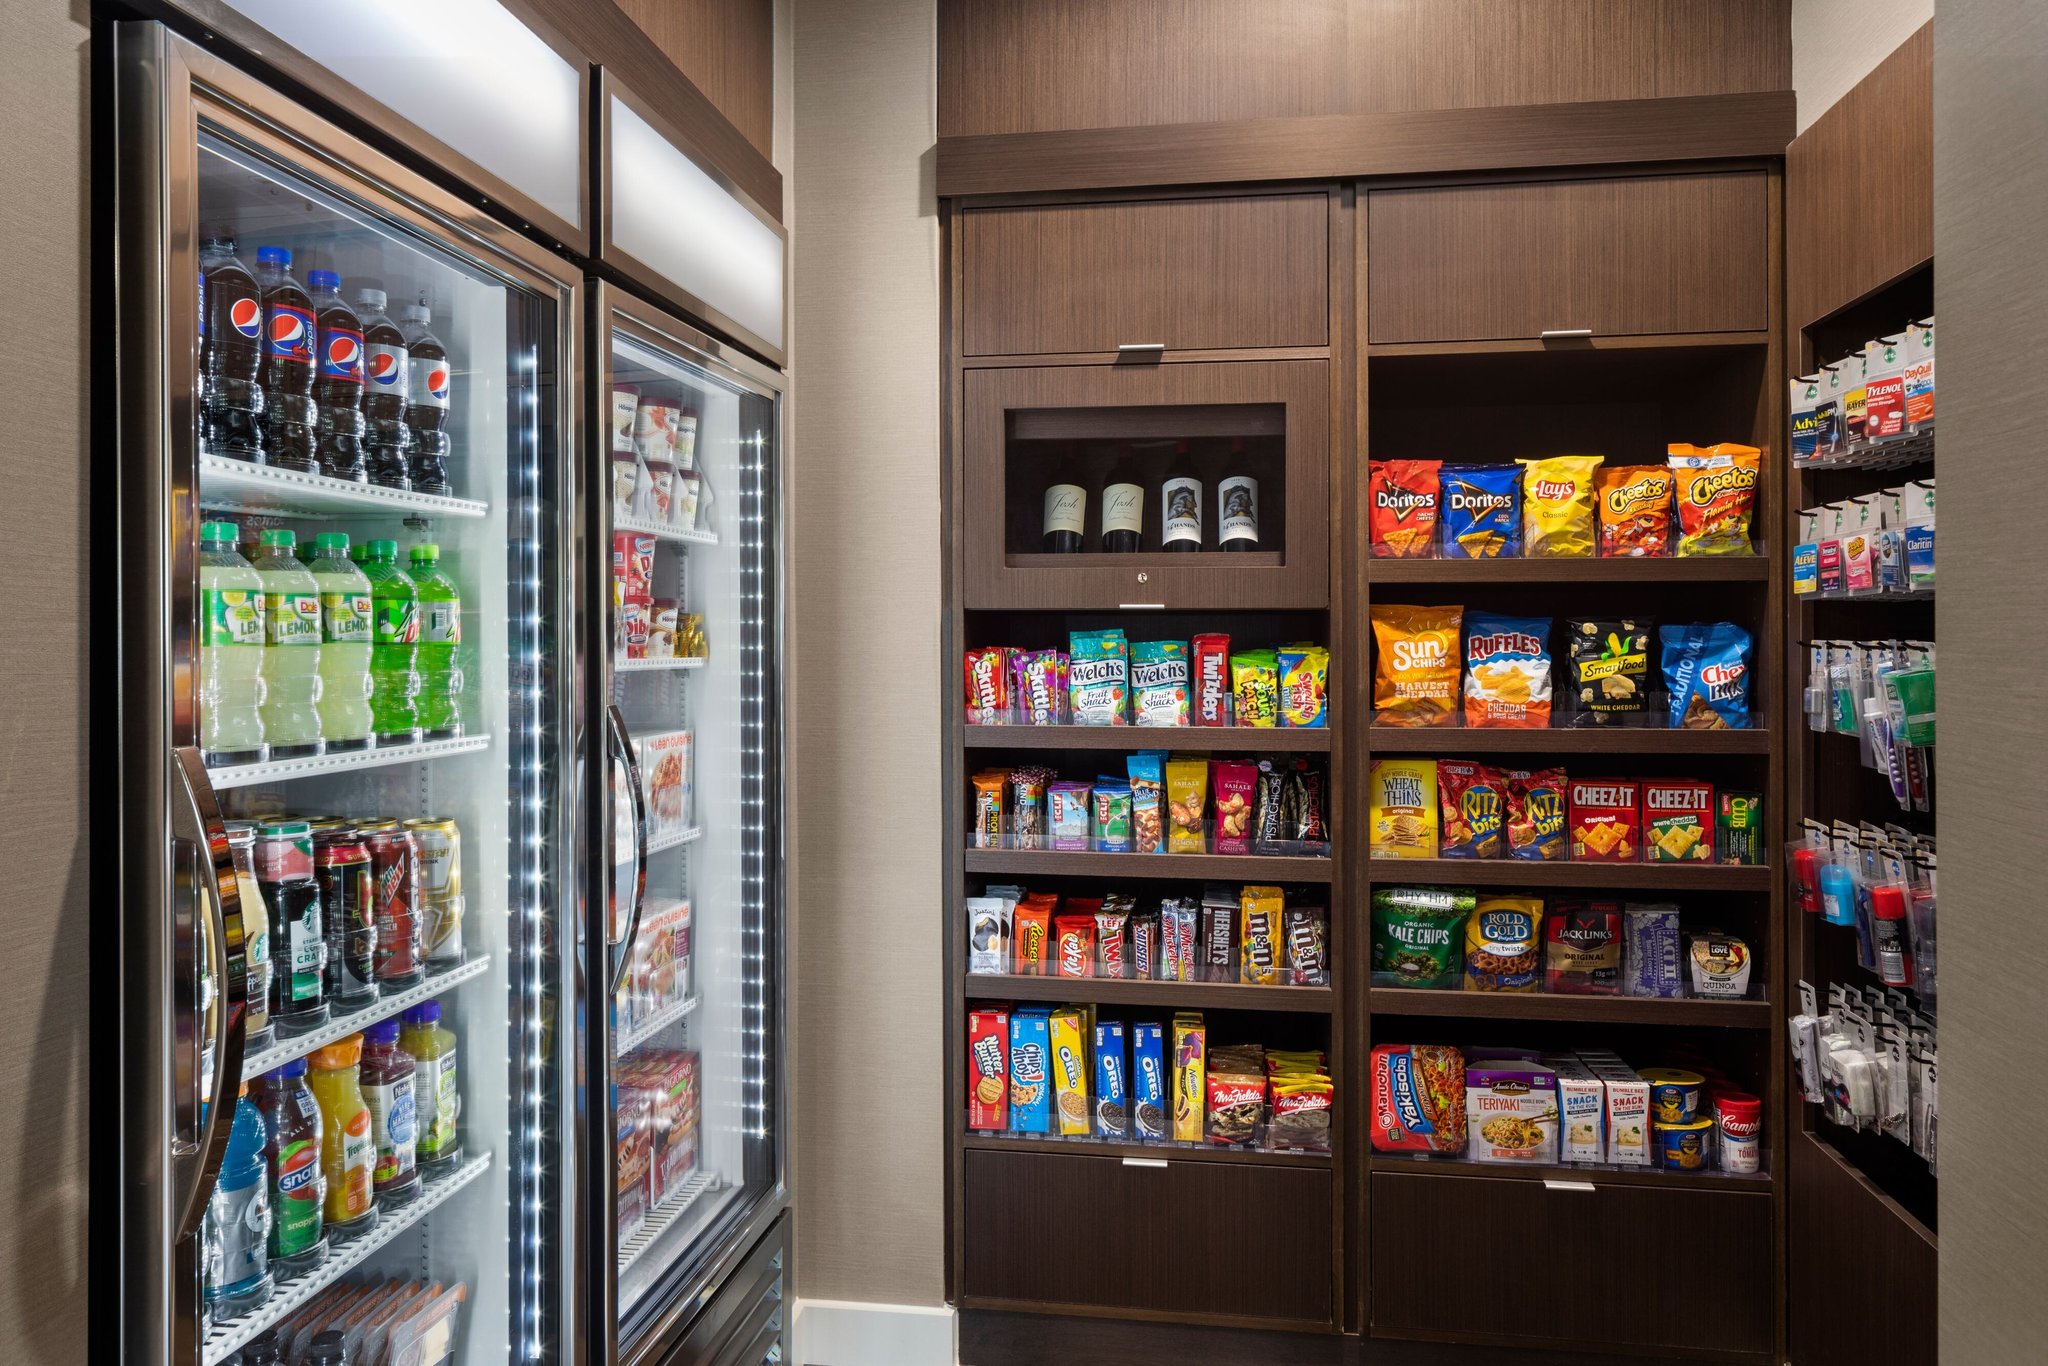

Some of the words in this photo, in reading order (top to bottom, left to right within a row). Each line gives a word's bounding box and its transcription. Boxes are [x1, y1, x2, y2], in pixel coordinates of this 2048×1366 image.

[1904, 362, 1932, 380] DayQuil
[1867, 383, 1902, 398] TYLENOL
[1846, 400, 1866, 411] BAYER
[1793, 418, 1818, 430] Advi
[1538, 481, 1573, 501] Lay's
[1691, 467, 1756, 506] Cheetos
[1378, 492, 1434, 508] Doritos
[1452, 493, 1512, 508] Doritos
[1610, 480, 1665, 513] Cheetos
[1542, 510, 1569, 519] Classic
[1908, 540, 1932, 550] Claritin
[1795, 555, 1816, 565] ALEVE
[1393, 640, 1448, 671] Sun
[1469, 632, 1541, 661] RUFFLES
[1073, 663, 1124, 681] Welch's
[1412, 658, 1446, 668] CHIPS
[1134, 664, 1186, 684] Welch's
[1670, 636, 1704, 716] TRADITIONAL
[974, 660, 996, 726] Skittles
[1087, 690, 1108, 700] Fruit
[1395, 690, 1450, 698] CHEDDAR
[1396, 681, 1450, 692] HARVEST
[1081, 698, 1112, 708] Snacks
[1144, 699, 1176, 709] Snacks
[1151, 692, 1171, 700] Fruit
[1242, 680, 1259, 720] PATCH
[1254, 682, 1271, 717] SOUR
[1488, 703, 1526, 713] CHEDDAR
[1612, 703, 1641, 711] CHEDDAR
[1383, 777, 1422, 790] WHEAT
[1463, 790, 1500, 820] RITZ
[1731, 798, 1748, 828] CLUB
[990, 811, 998, 848] PROTEIN
[1102, 919, 1122, 928] LEFT
[1488, 913, 1524, 925] ROLD
[1388, 924, 1414, 943] KALE
[1417, 928, 1450, 945] CHIPS
[1485, 924, 1528, 940] GOLD
[1558, 930, 1584, 940] JACK
[1103, 930, 1124, 978] TWIX
[1136, 928, 1148, 971] SATISFIES
[1662, 936, 1675, 962] ACT
[1702, 982, 1736, 990] QUINOA
[974, 1041, 995, 1078] Butter
[984, 1036, 1004, 1074] Nutter
[1023, 1044, 1040, 1076] Chips
[1059, 1046, 1077, 1088] OREO
[1103, 1056, 1118, 1099] OREO
[1142, 1056, 1158, 1100] OREO
[1188, 1068, 1198, 1098] Newtons
[1377, 1054, 1388, 1117] Maruchan
[1395, 1058, 1421, 1130] Yakisoba
[1566, 1095, 1598, 1106] SNACK
[1613, 1096, 1644, 1106] SNACK
[1477, 1098, 1520, 1111] TERIYAKI
